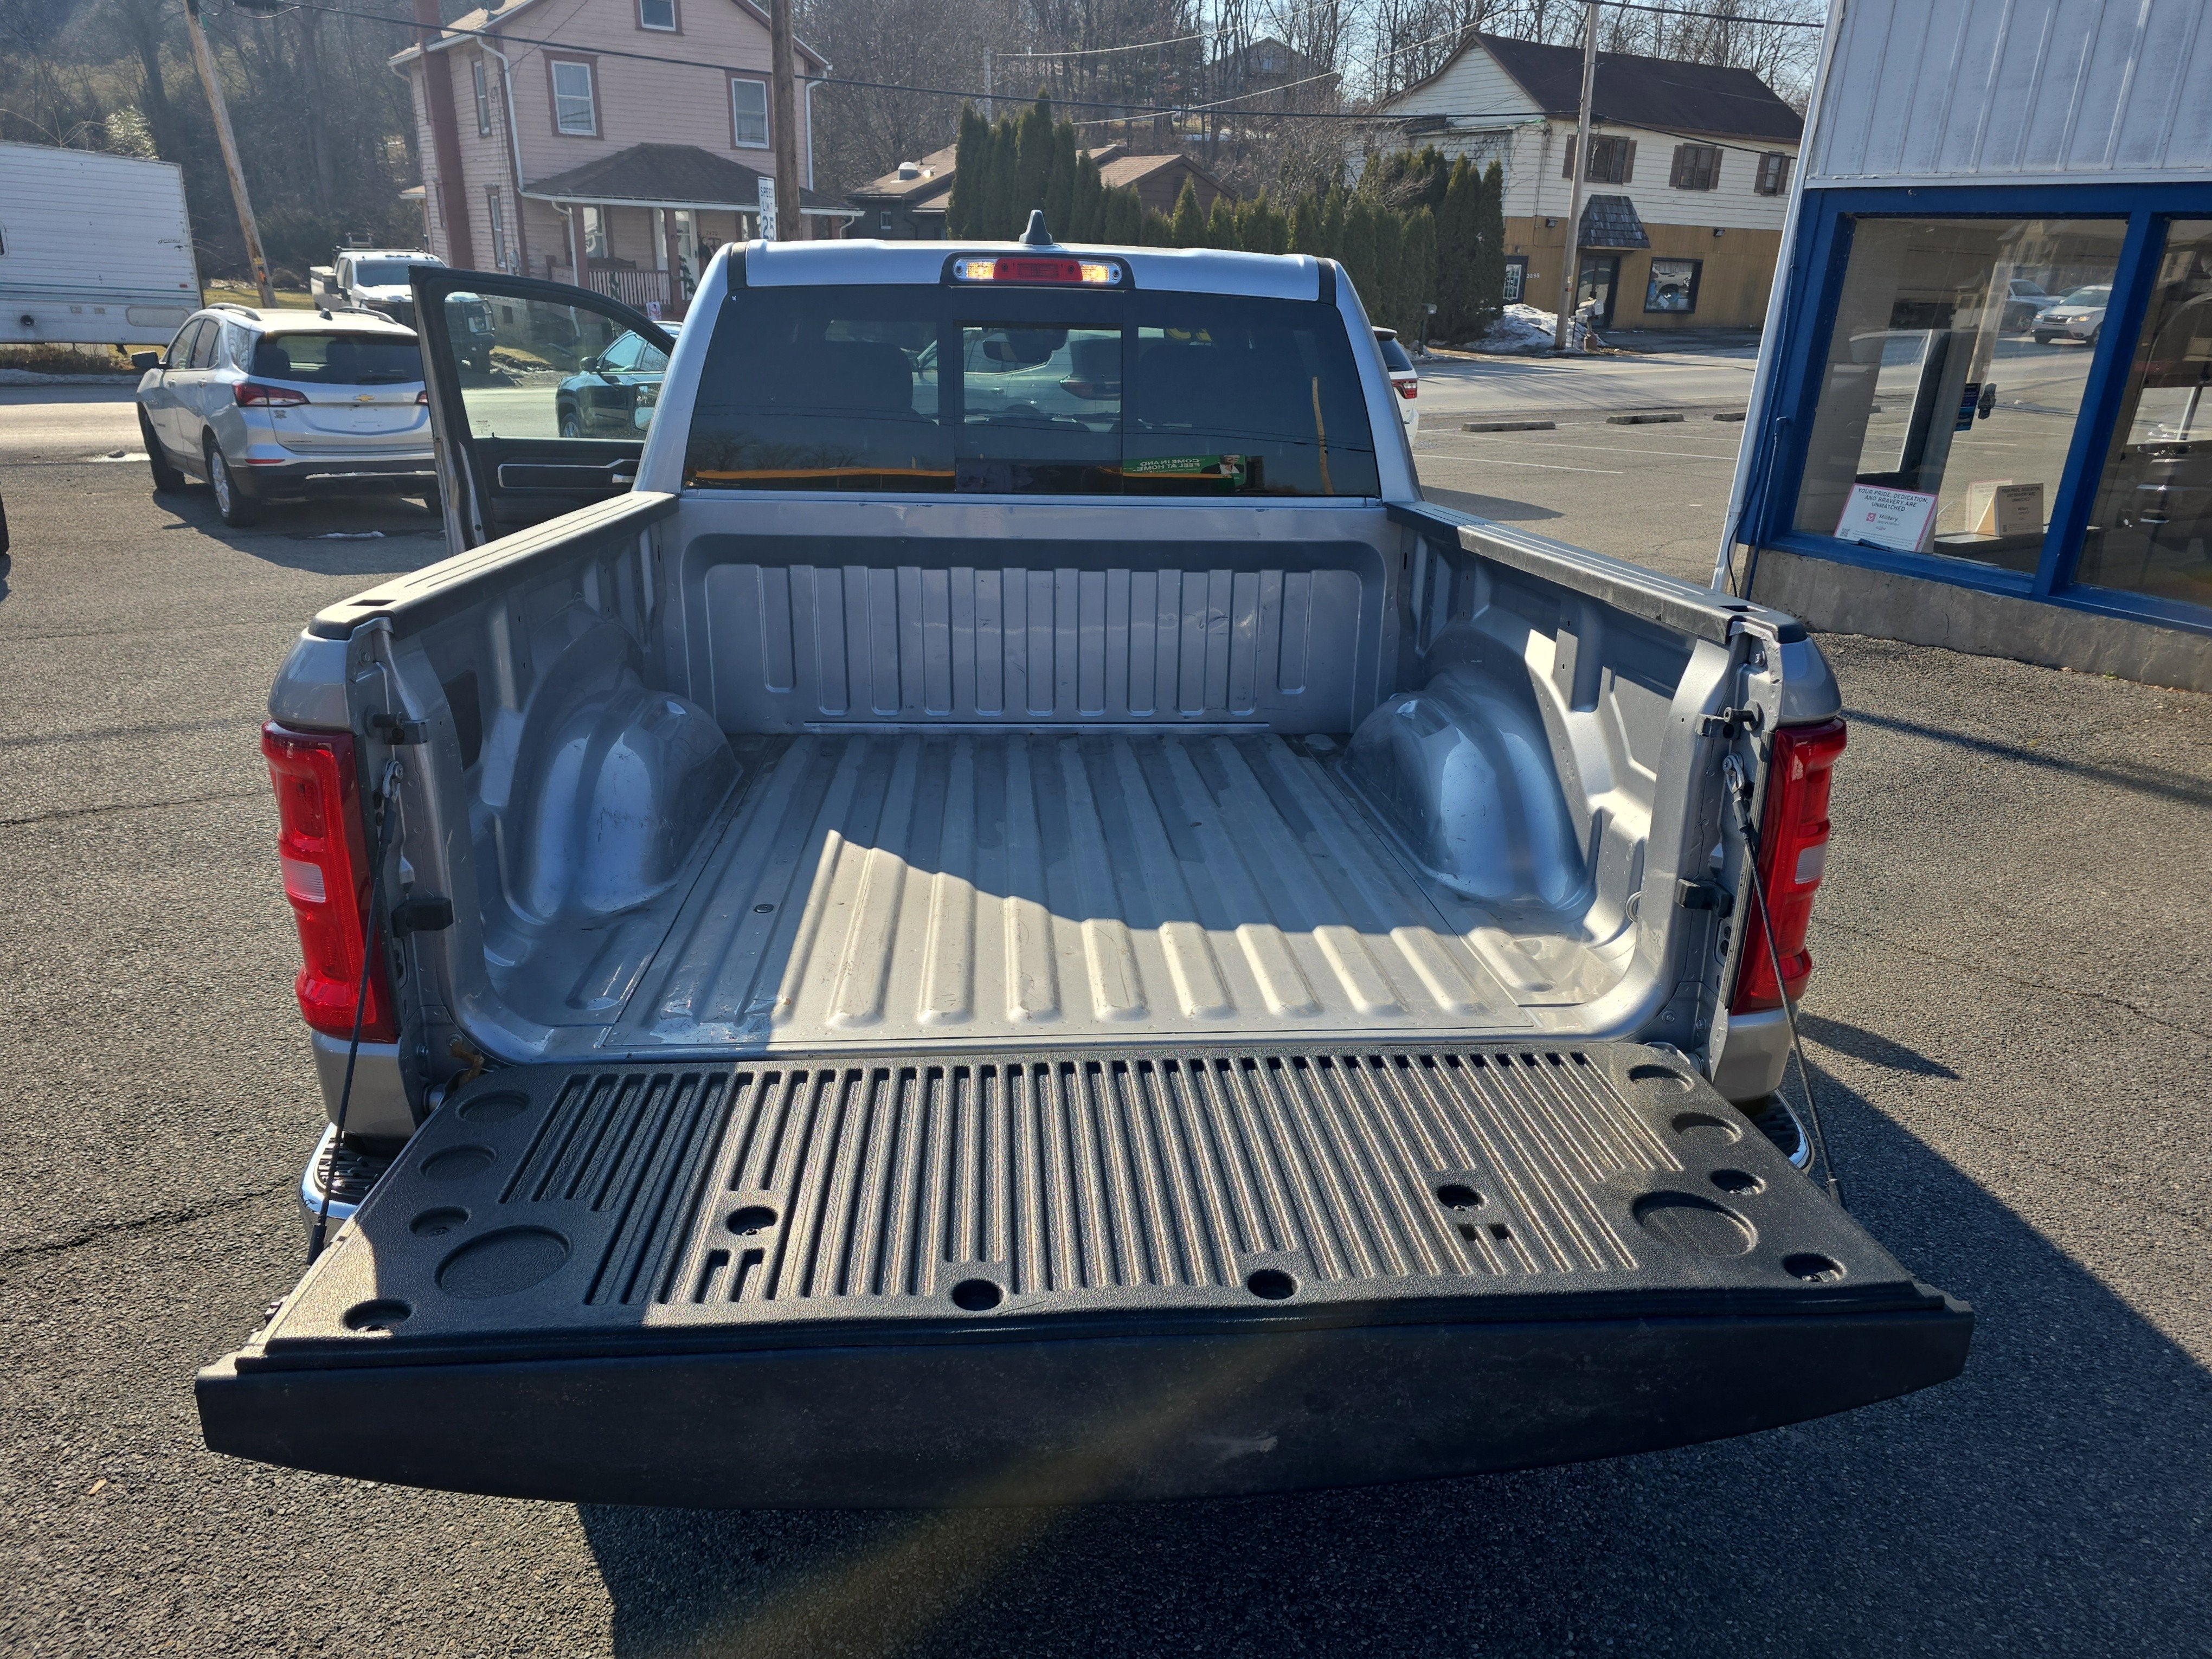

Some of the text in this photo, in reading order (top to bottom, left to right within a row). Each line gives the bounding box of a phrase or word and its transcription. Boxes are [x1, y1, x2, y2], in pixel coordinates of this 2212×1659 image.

[760, 187, 773, 198] SPEED
[762, 215, 775, 240] 25
[1878, 498, 1904, 506] BRAVERY
[1894, 493, 1928, 504] DEDICATION,
[1872, 502, 1906, 512] UNMATCHED
[1879, 514, 1899, 522] Military
